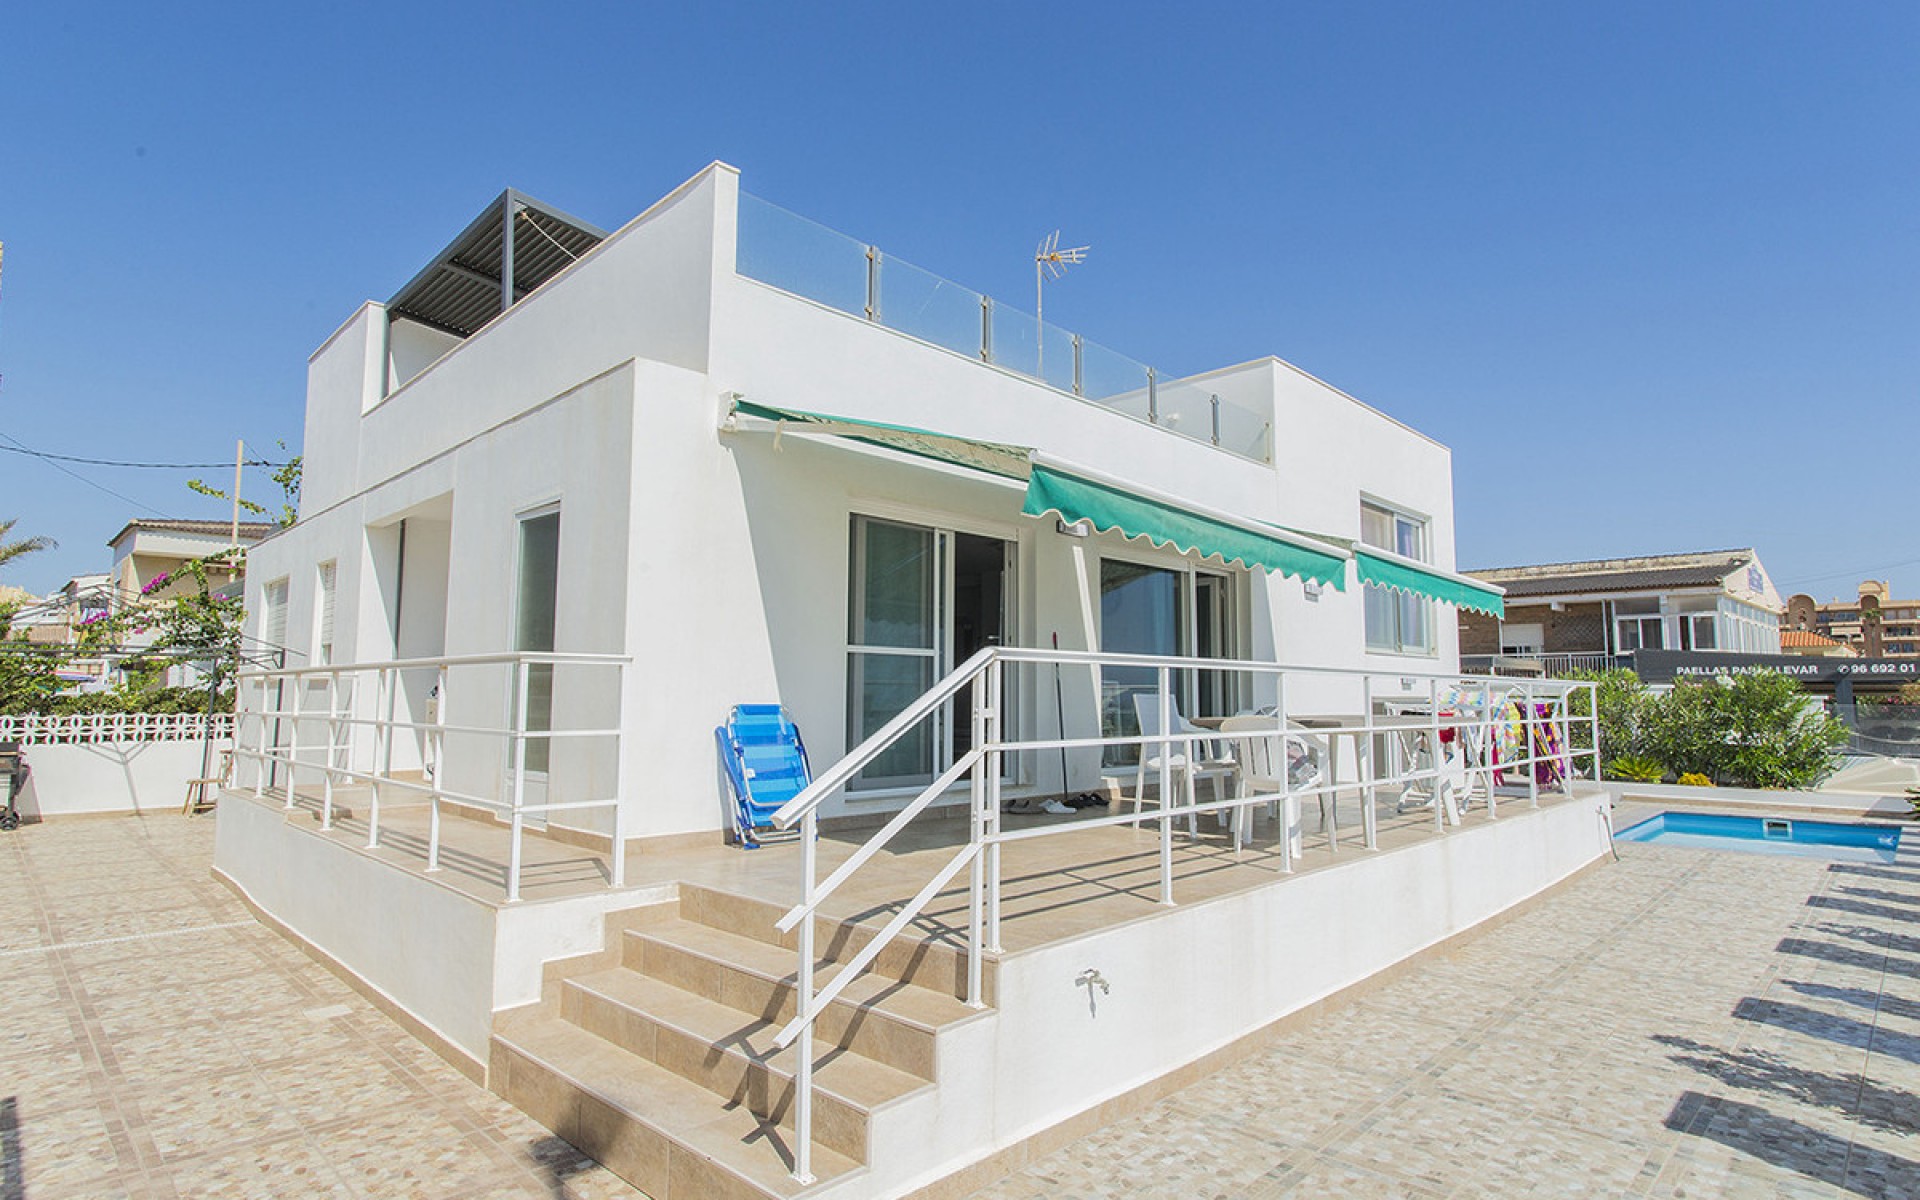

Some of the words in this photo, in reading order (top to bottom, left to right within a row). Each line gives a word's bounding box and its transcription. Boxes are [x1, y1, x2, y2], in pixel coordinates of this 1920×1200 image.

[1850, 663, 1868, 673] 96
[1871, 663, 1896, 673] 692
[1899, 663, 1916, 673] 01
